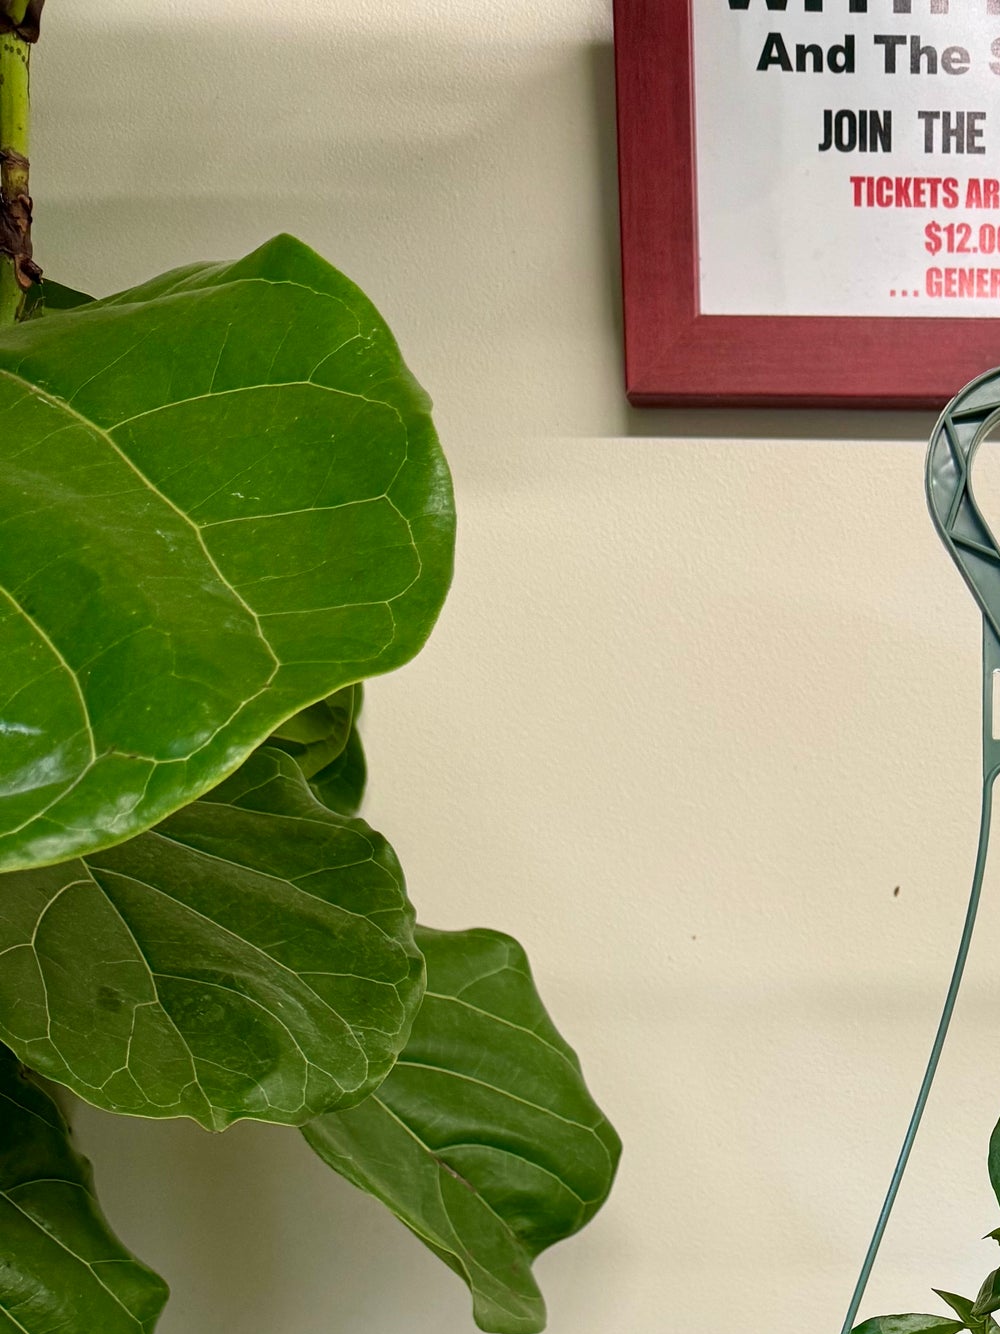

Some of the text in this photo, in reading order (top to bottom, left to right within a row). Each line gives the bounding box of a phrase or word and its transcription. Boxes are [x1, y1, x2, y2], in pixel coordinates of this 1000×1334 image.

[757, 32, 855, 74] And
[874, 34, 971, 75] The
[819, 109, 892, 153] JOIN
[918, 111, 986, 154] THE
[850, 176, 959, 208] TICKETS
